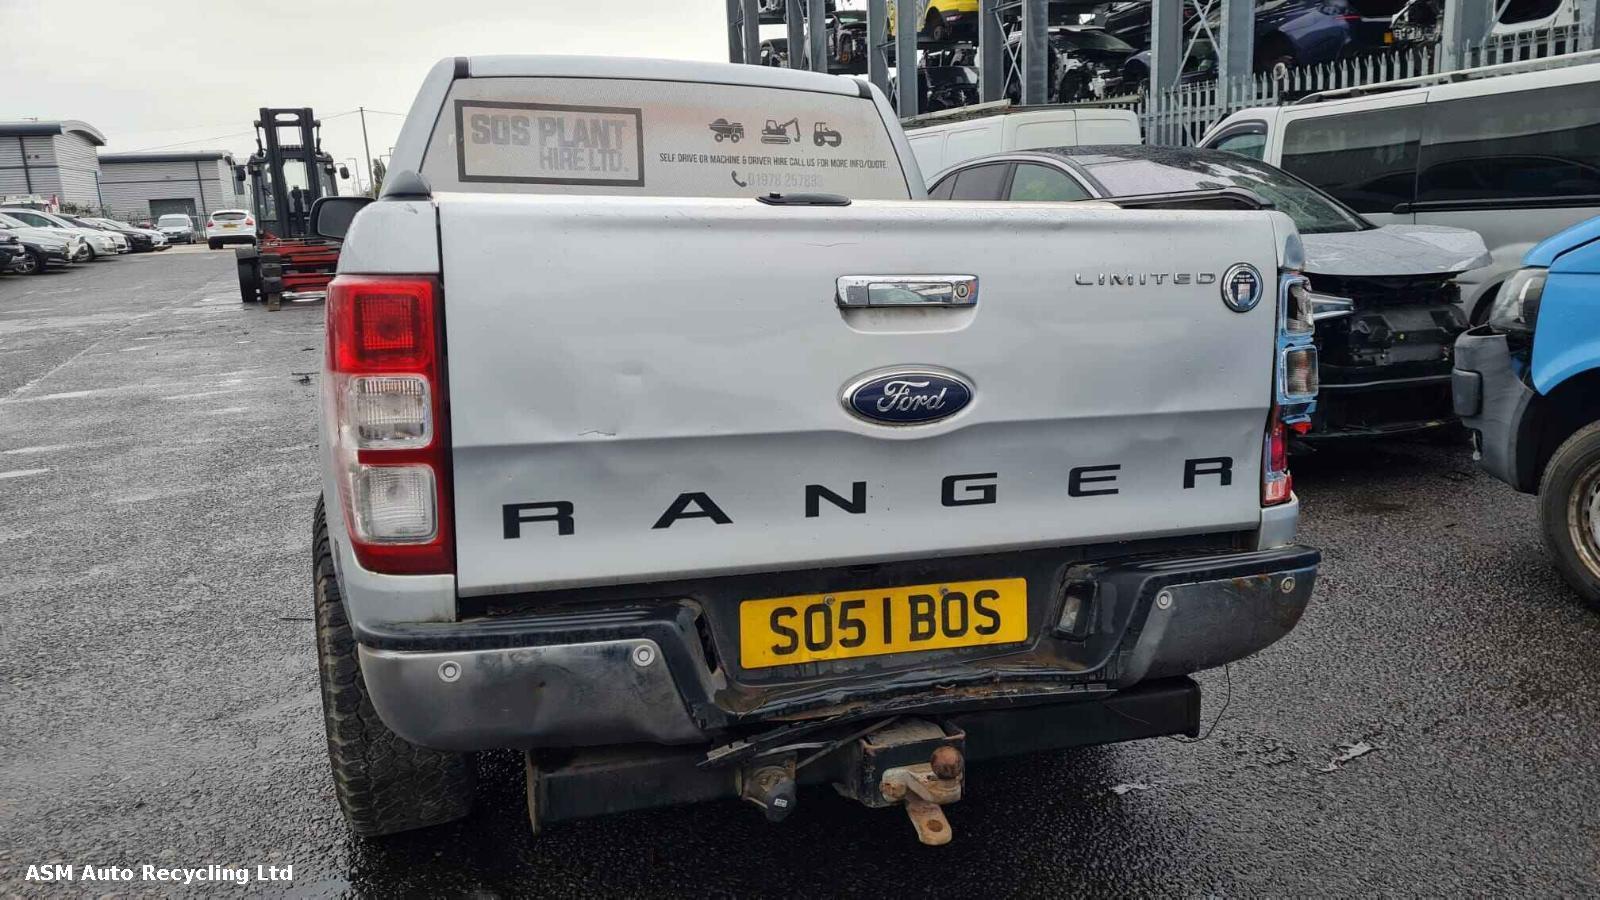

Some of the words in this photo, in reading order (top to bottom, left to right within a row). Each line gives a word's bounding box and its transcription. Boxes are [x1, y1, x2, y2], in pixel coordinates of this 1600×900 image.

[470, 113, 530, 146] SOS
[537, 117, 626, 149] PLANT
[538, 148, 585, 171] HIRE
[659, 153, 676, 163] SELF
[677, 153, 698, 163] DRIVE
[699, 154, 709, 164] OR
[710, 155, 740, 164] MACHINE
[748, 156, 772, 166] DRIVER
[773, 157, 788, 166] HIRE
[789, 157, 806, 167] CALL
[806, 158, 815, 167] US
[816, 158, 829, 168] FOR
[830, 159, 848, 168] MORE
[1075, 273, 1216, 286] LIMITED
[876, 380, 948, 412] Ford
[502, 456, 1234, 540] RANGER
[908, 589, 1001, 641] BOS
